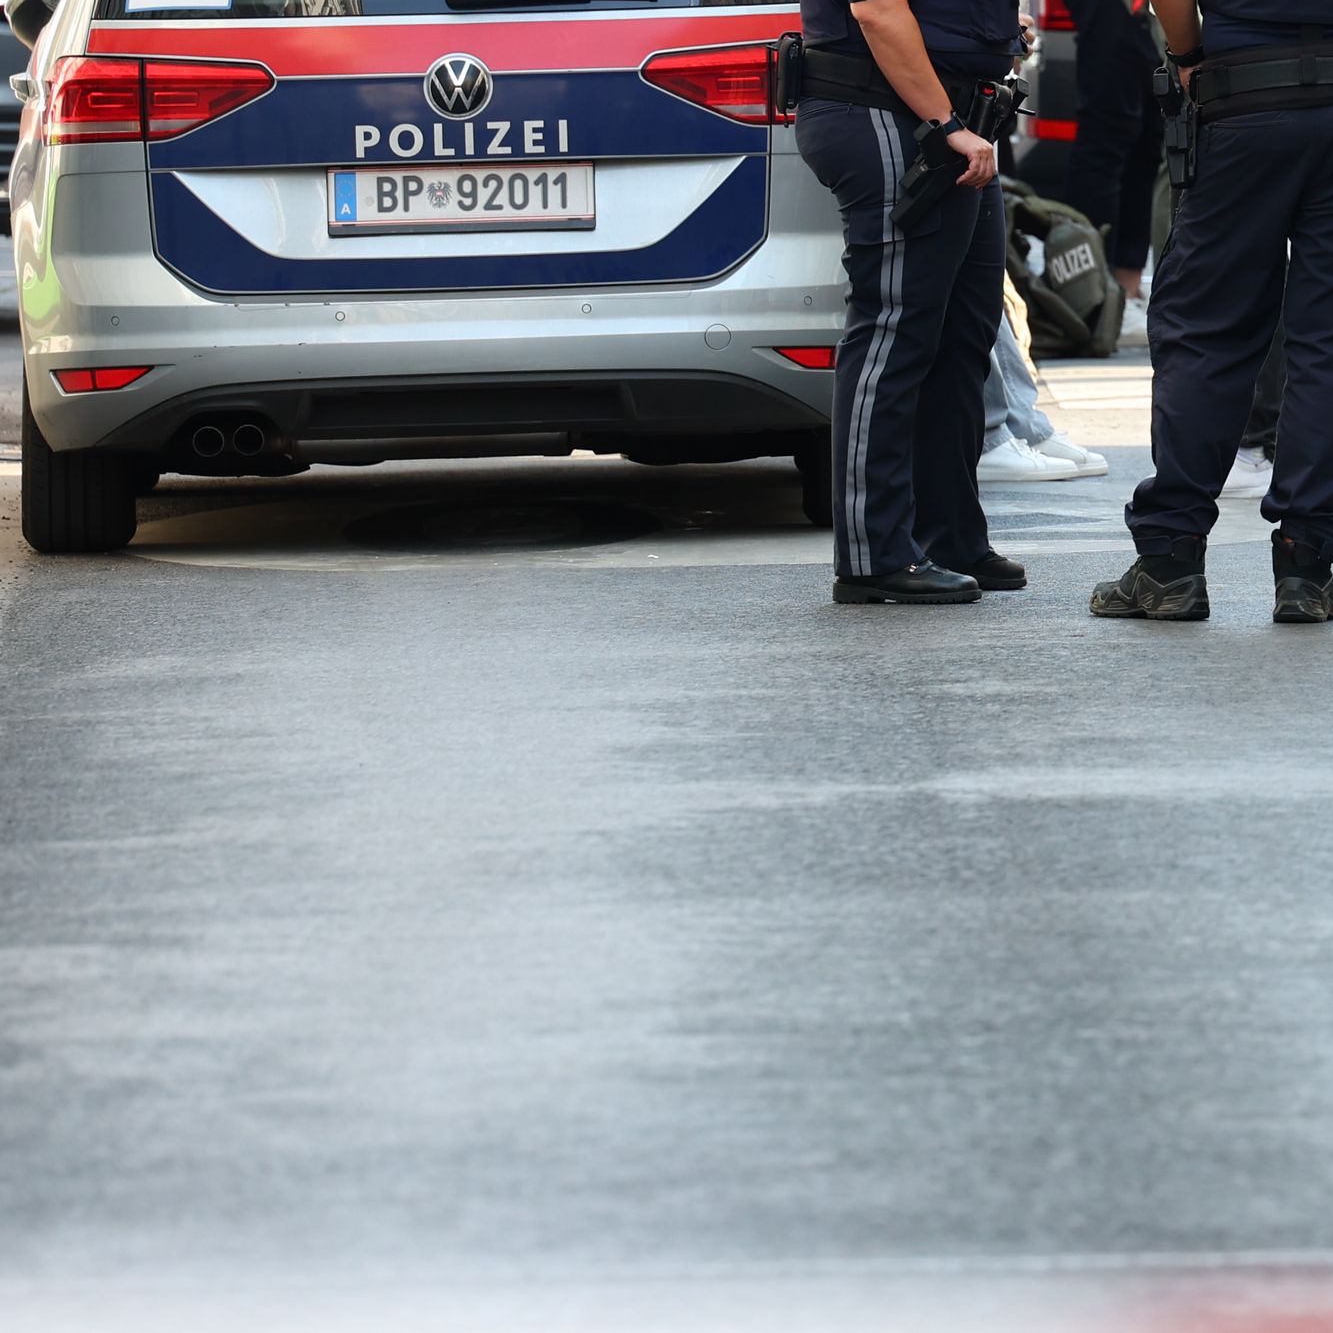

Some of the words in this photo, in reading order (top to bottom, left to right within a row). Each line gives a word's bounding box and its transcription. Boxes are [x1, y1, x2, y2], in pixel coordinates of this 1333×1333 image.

[355, 119, 568, 158] POLIZEI
[340, 203, 351, 215] A
[376, 176, 423, 213] BP
[456, 172, 567, 212] 92011
[1051, 243, 1095, 284] OLIZEI
